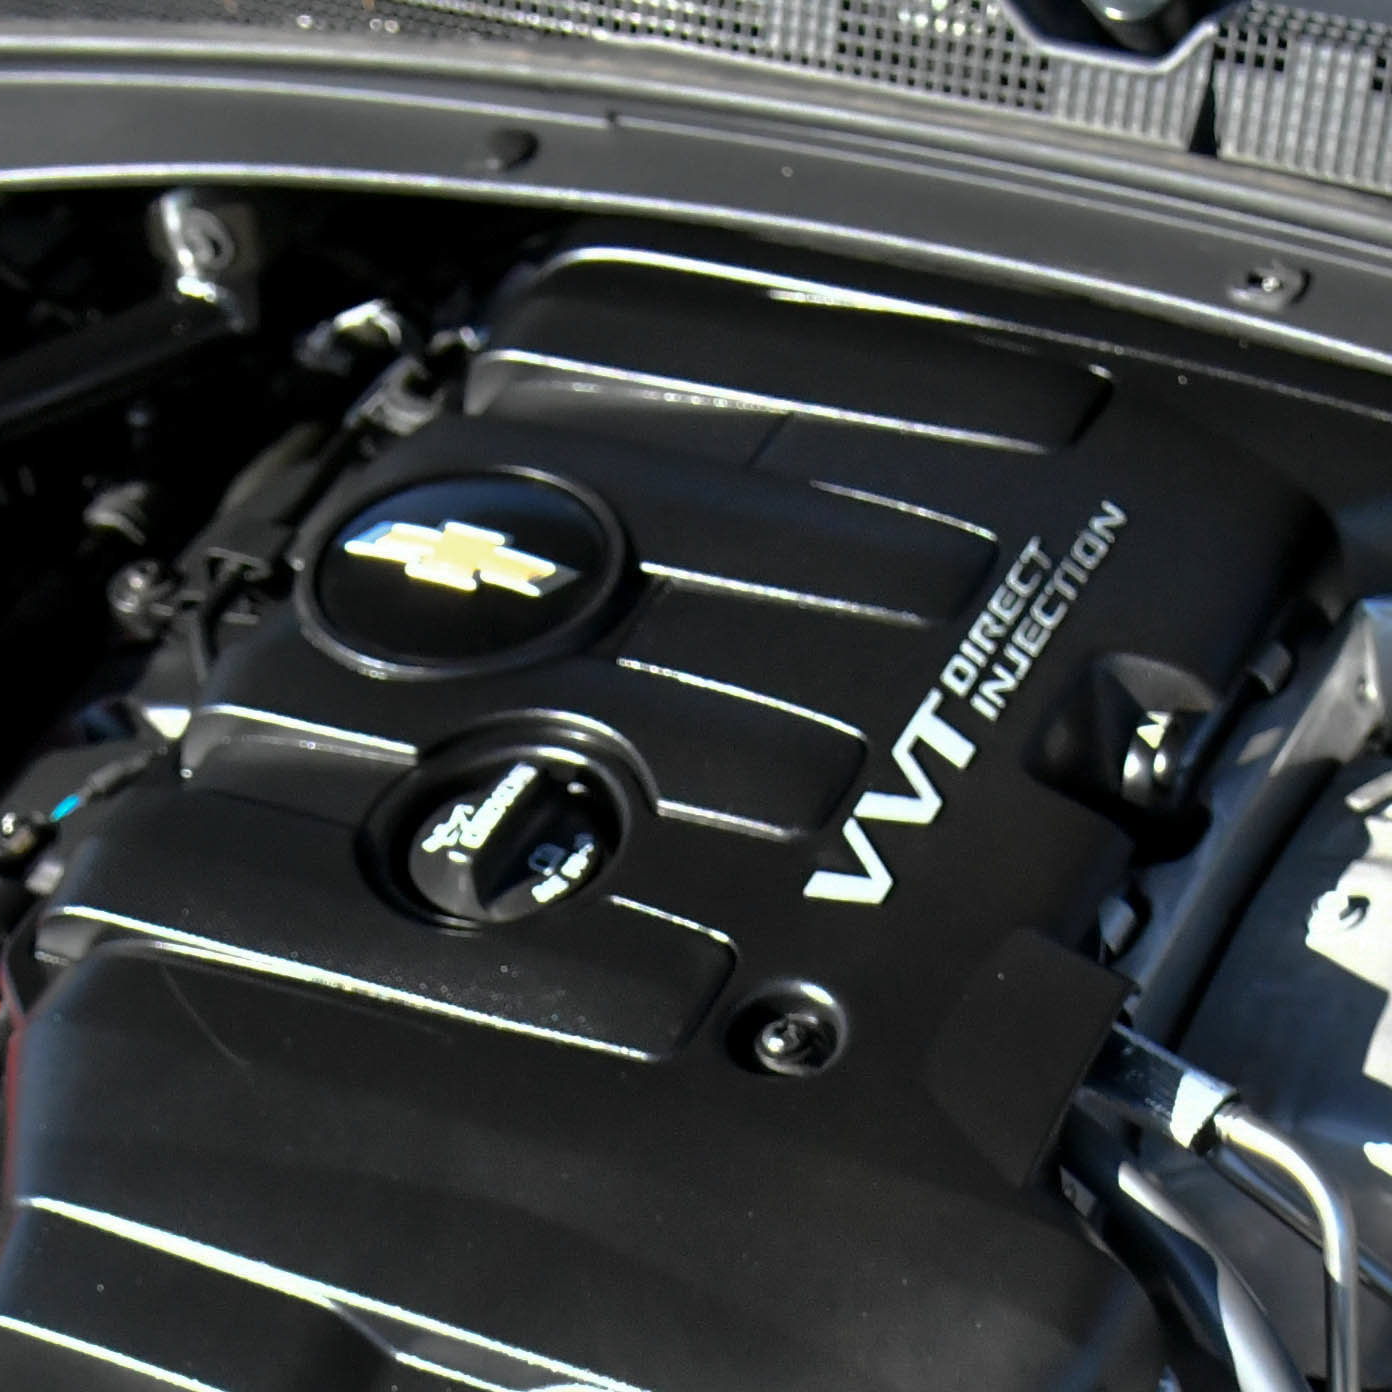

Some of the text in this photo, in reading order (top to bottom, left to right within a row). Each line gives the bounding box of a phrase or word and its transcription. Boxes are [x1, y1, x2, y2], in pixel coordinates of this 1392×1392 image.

[940, 535, 1053, 699] DIRECT
[970, 499, 1128, 721] INJECTION
[803, 687, 977, 905] VVT
